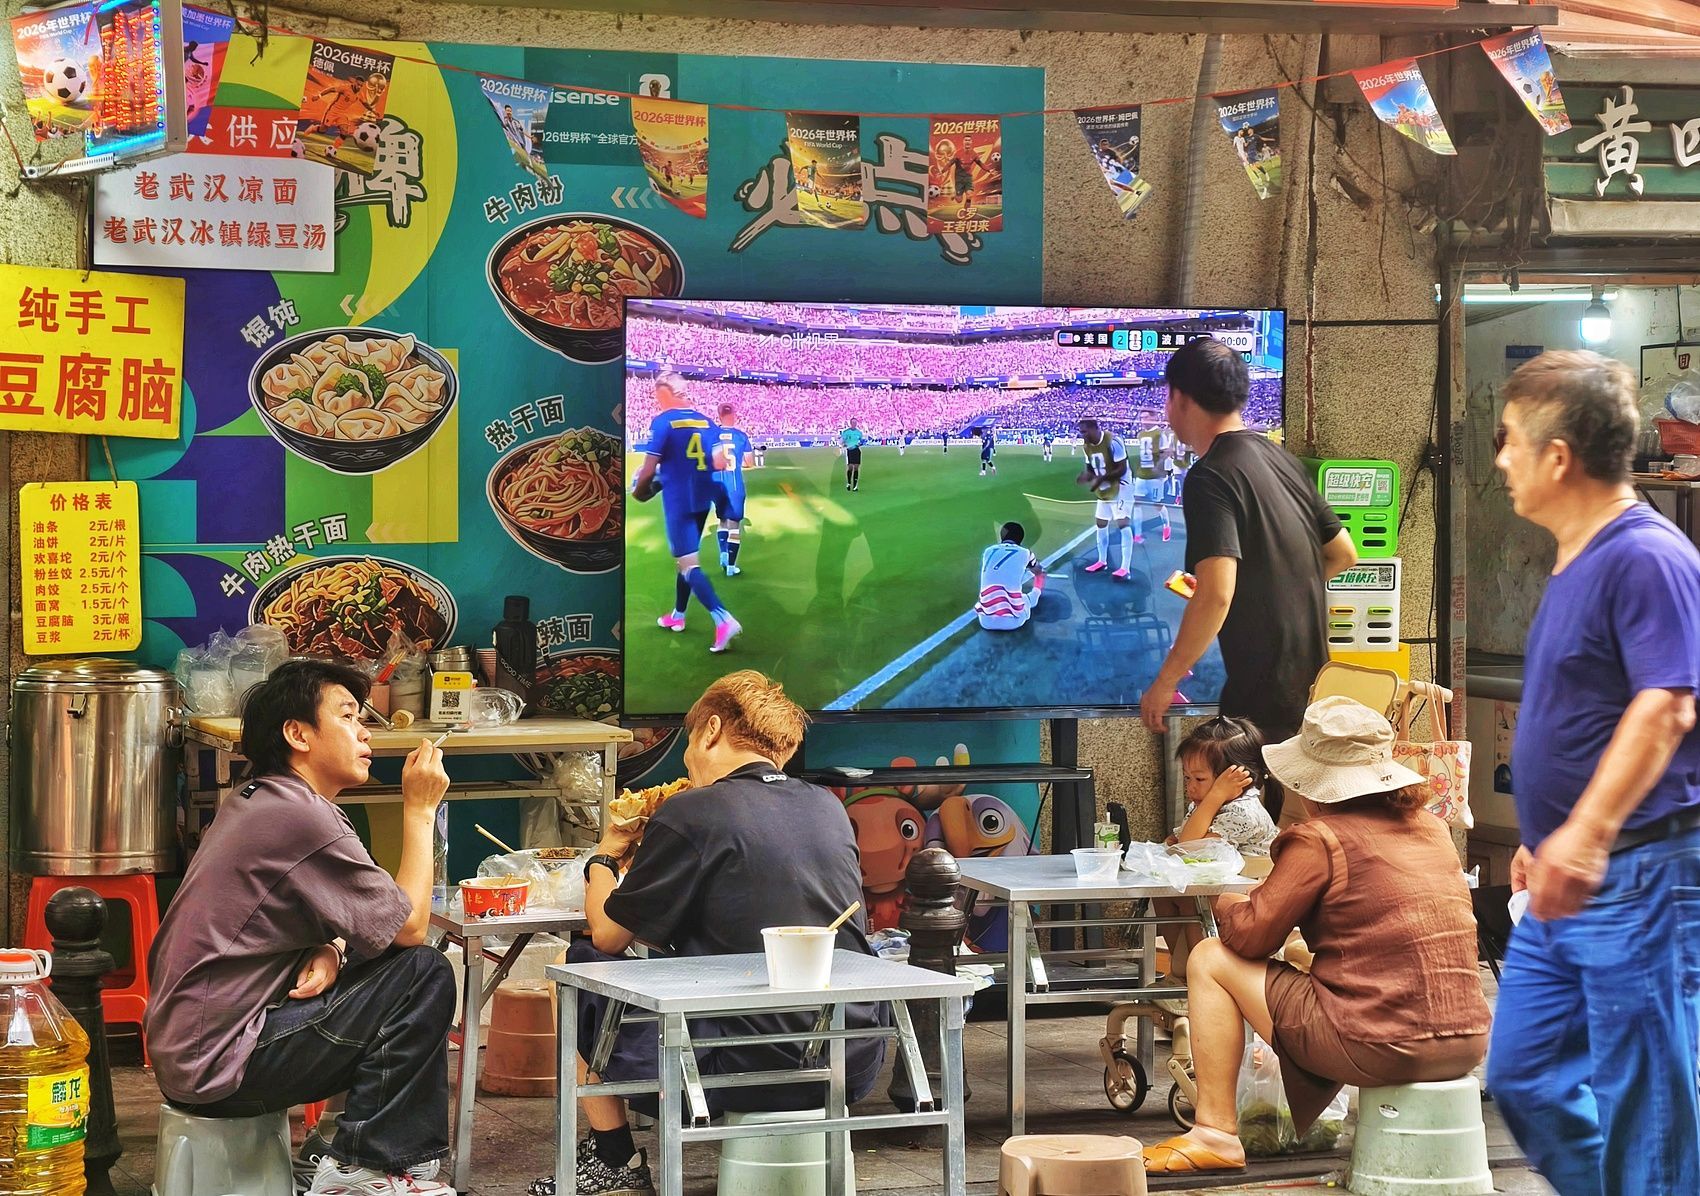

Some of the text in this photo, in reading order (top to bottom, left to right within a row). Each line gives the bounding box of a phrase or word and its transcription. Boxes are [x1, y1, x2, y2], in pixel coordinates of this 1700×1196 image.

[17, 12, 92, 39] 2026年世界杯
[314, 43, 391, 74] 2026世界杯
[1360, 70, 1422, 91] 2026年世界杯
[480, 78, 548, 103] 2026世界杯
[549, 88, 620, 106] isense
[1218, 97, 1276, 118] 2026年世界杯
[634, 110, 706, 127] 2026年世界杯
[933, 119, 999, 135] 2026世界杯
[790, 127, 857, 142] 2026年世界杯
[832, 142, 843, 150] Cup
[133, 171, 298, 206] 老武汉凉面
[483, 175, 565, 225] 牛肉粉
[956, 207, 977, 221] C罗
[103, 216, 328, 251] 老武汉冰镇绿豆汤
[941, 220, 990, 233] 王者归来
[18, 286, 151, 335] 纯手工
[240, 298, 300, 348] 馄饨
[1083, 333, 1109, 345] 美国
[0, 352, 176, 424] 豆腐脑
[485, 394, 565, 452] 热干面
[686, 432, 708, 471] 4
[723, 443, 737, 472] 5
[50, 493, 112, 512] 价格表
[32, 519, 126, 533] 油条 2元/根
[33, 534, 126, 549] 油饼 2元/片
[33, 551, 127, 565] 欢喜坨 2元/个
[219, 513, 348, 599] 牛肉热干面
[33, 566, 128, 581] 粉丝饺 2.5元/个
[35, 582, 129, 597] 肉饺 2.5元/个
[35, 598, 129, 612] 面窝 1.5元/个
[36, 613, 130, 628] 豆腐脑 3元/碗
[36, 628, 131, 644] 豆浆 2元/杯
